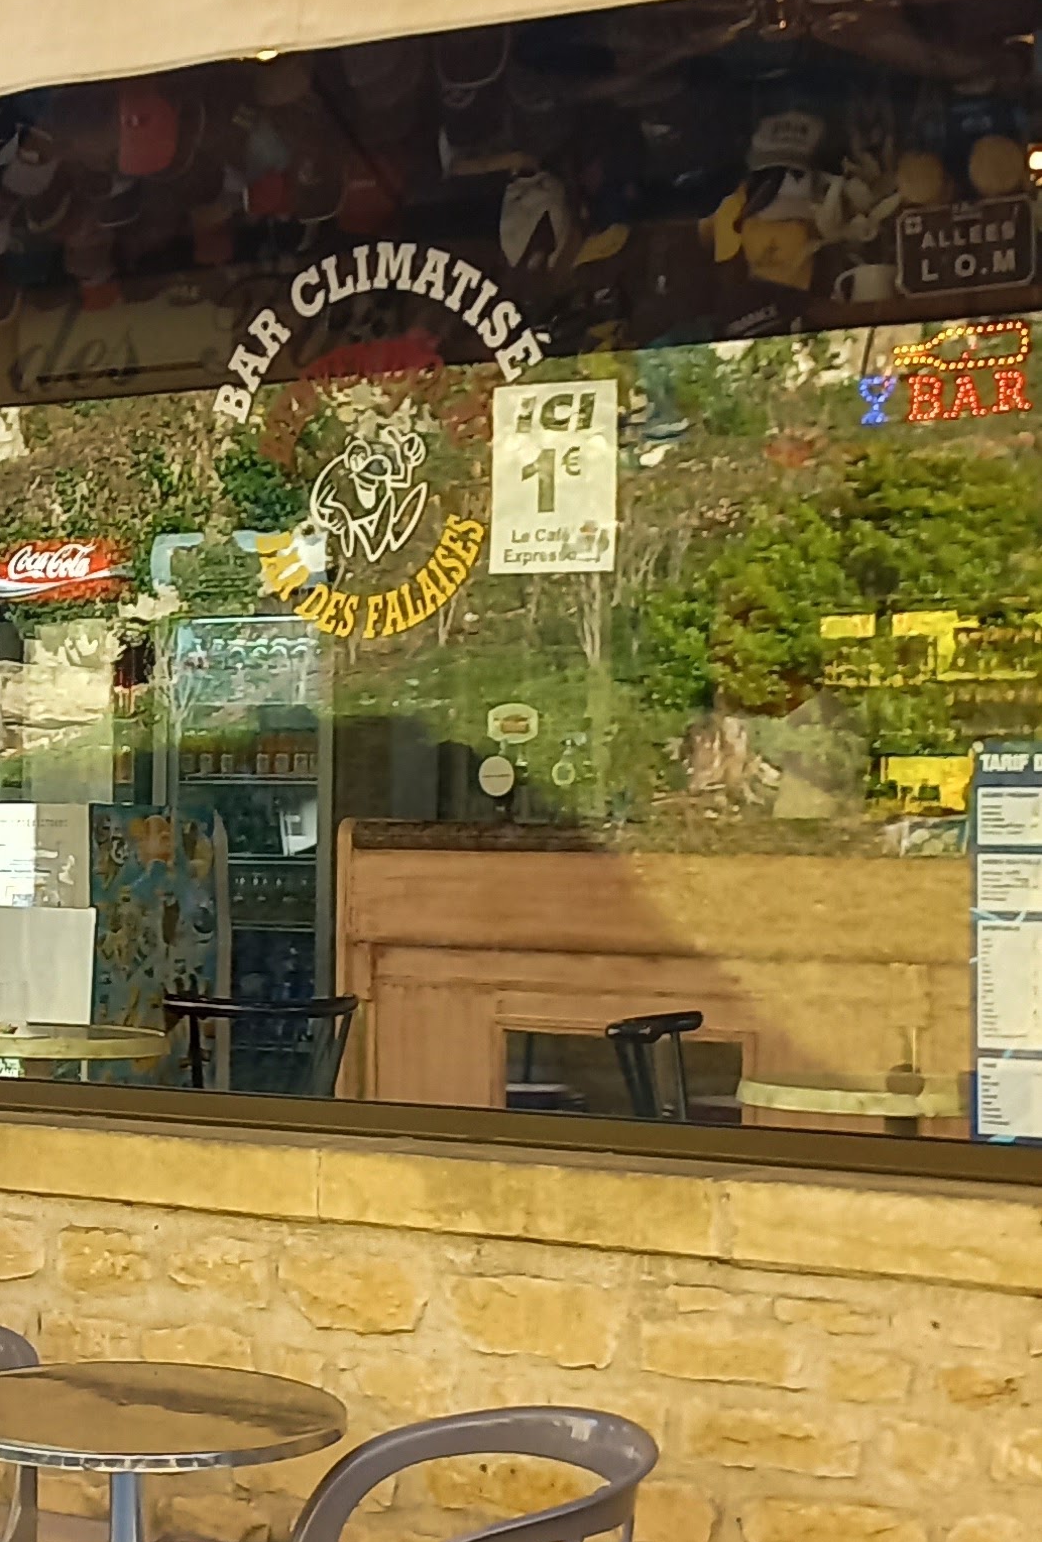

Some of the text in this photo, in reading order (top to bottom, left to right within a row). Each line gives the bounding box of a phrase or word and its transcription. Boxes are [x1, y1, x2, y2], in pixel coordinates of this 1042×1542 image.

[212, 241, 551, 424] BAR CLIMATISÉ
[908, 370, 1032, 421] BAR
[294, 582, 359, 638] DES
[362, 514, 485, 639] FALAISES
[511, 529, 531, 543] Le
